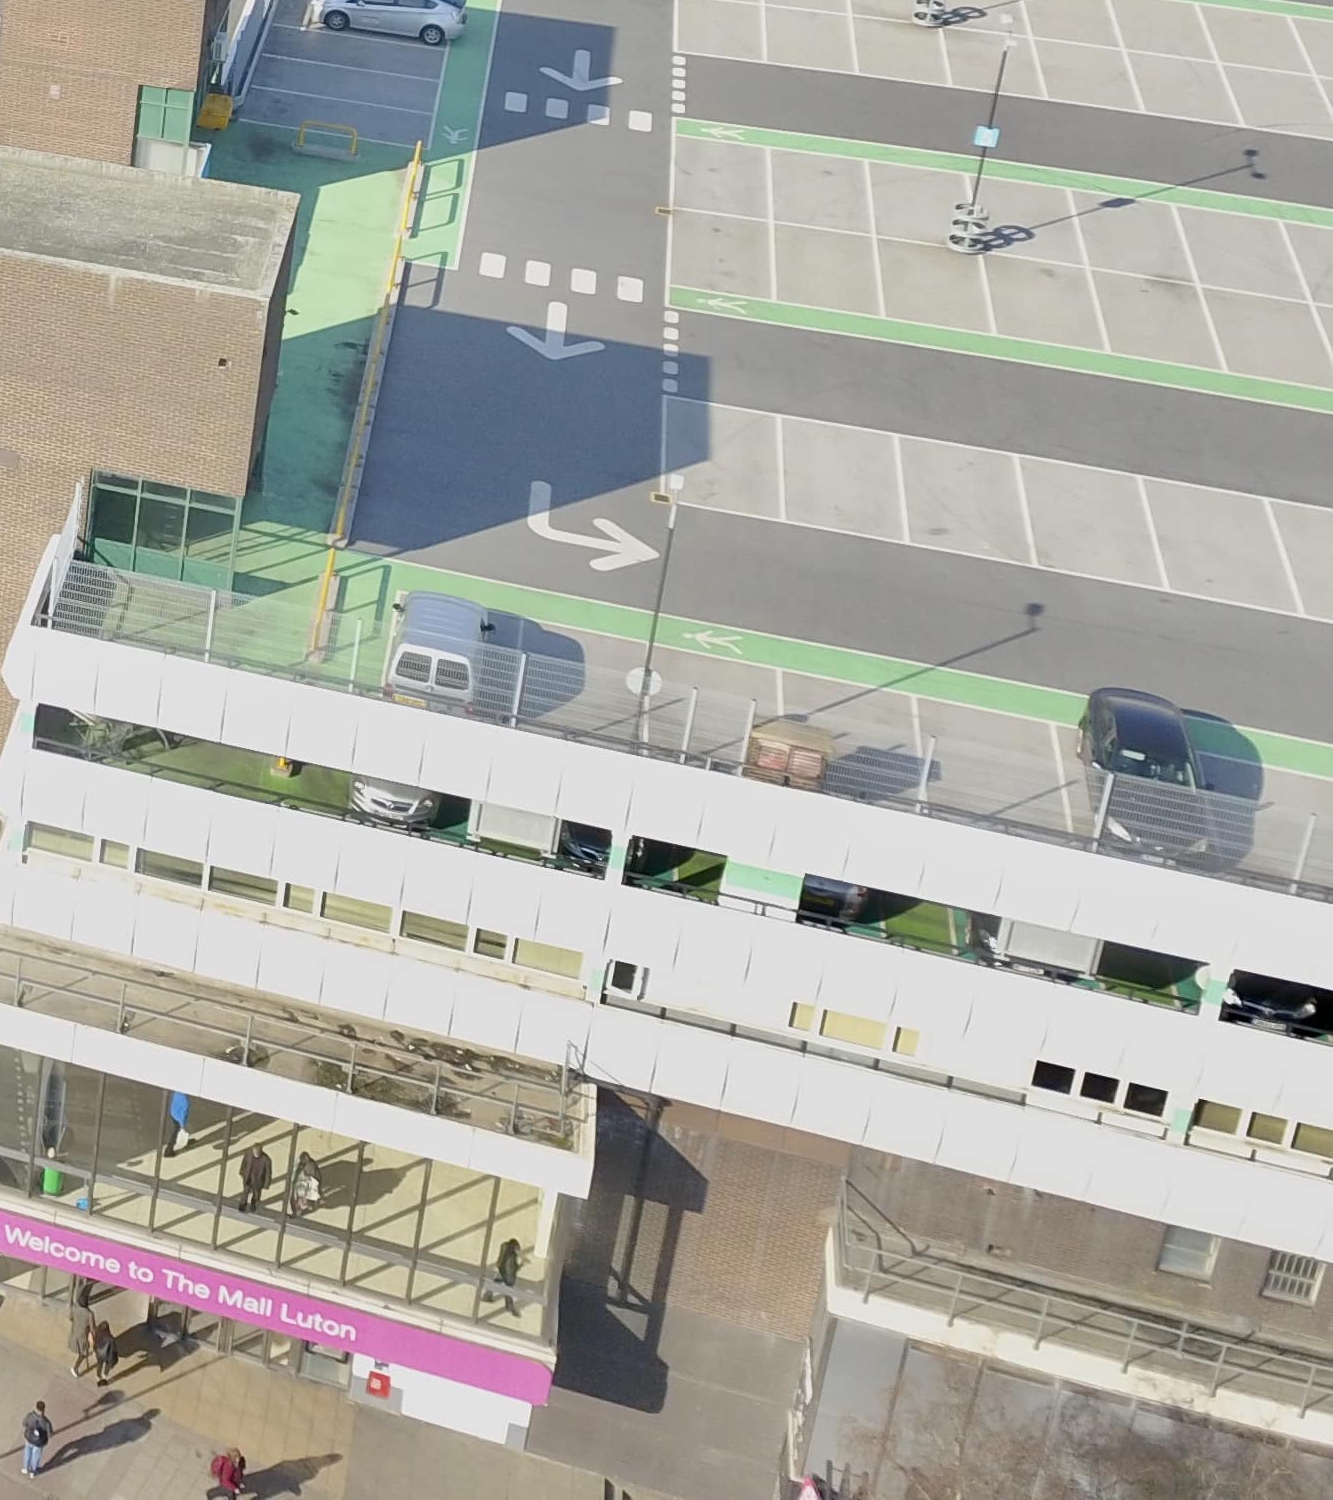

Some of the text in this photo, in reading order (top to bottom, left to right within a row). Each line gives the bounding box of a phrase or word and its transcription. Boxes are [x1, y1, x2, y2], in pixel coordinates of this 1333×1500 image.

[5, 1224, 357, 1341] Welcome to The Mall Luton
